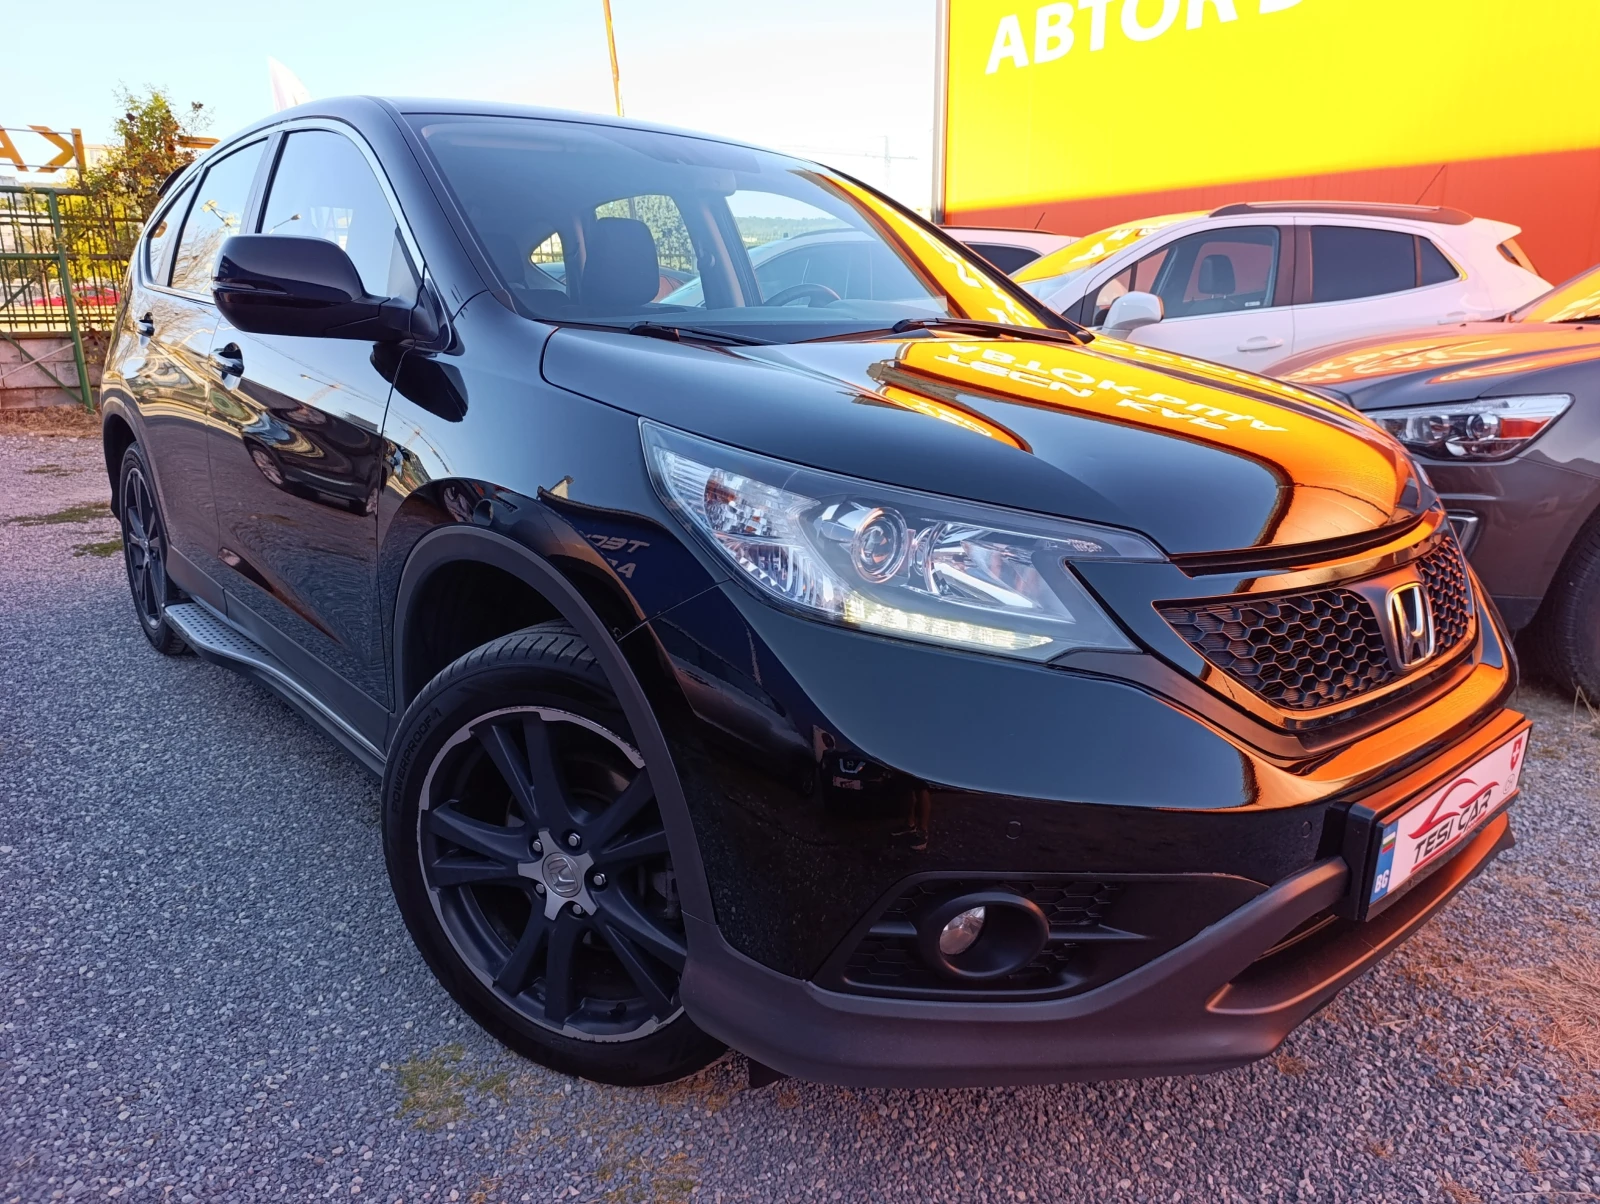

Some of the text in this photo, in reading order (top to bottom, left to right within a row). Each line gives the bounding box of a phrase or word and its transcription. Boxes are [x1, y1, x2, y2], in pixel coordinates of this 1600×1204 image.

[1413, 789, 1492, 864] TESI CAR
[1374, 869, 1391, 894] BG
